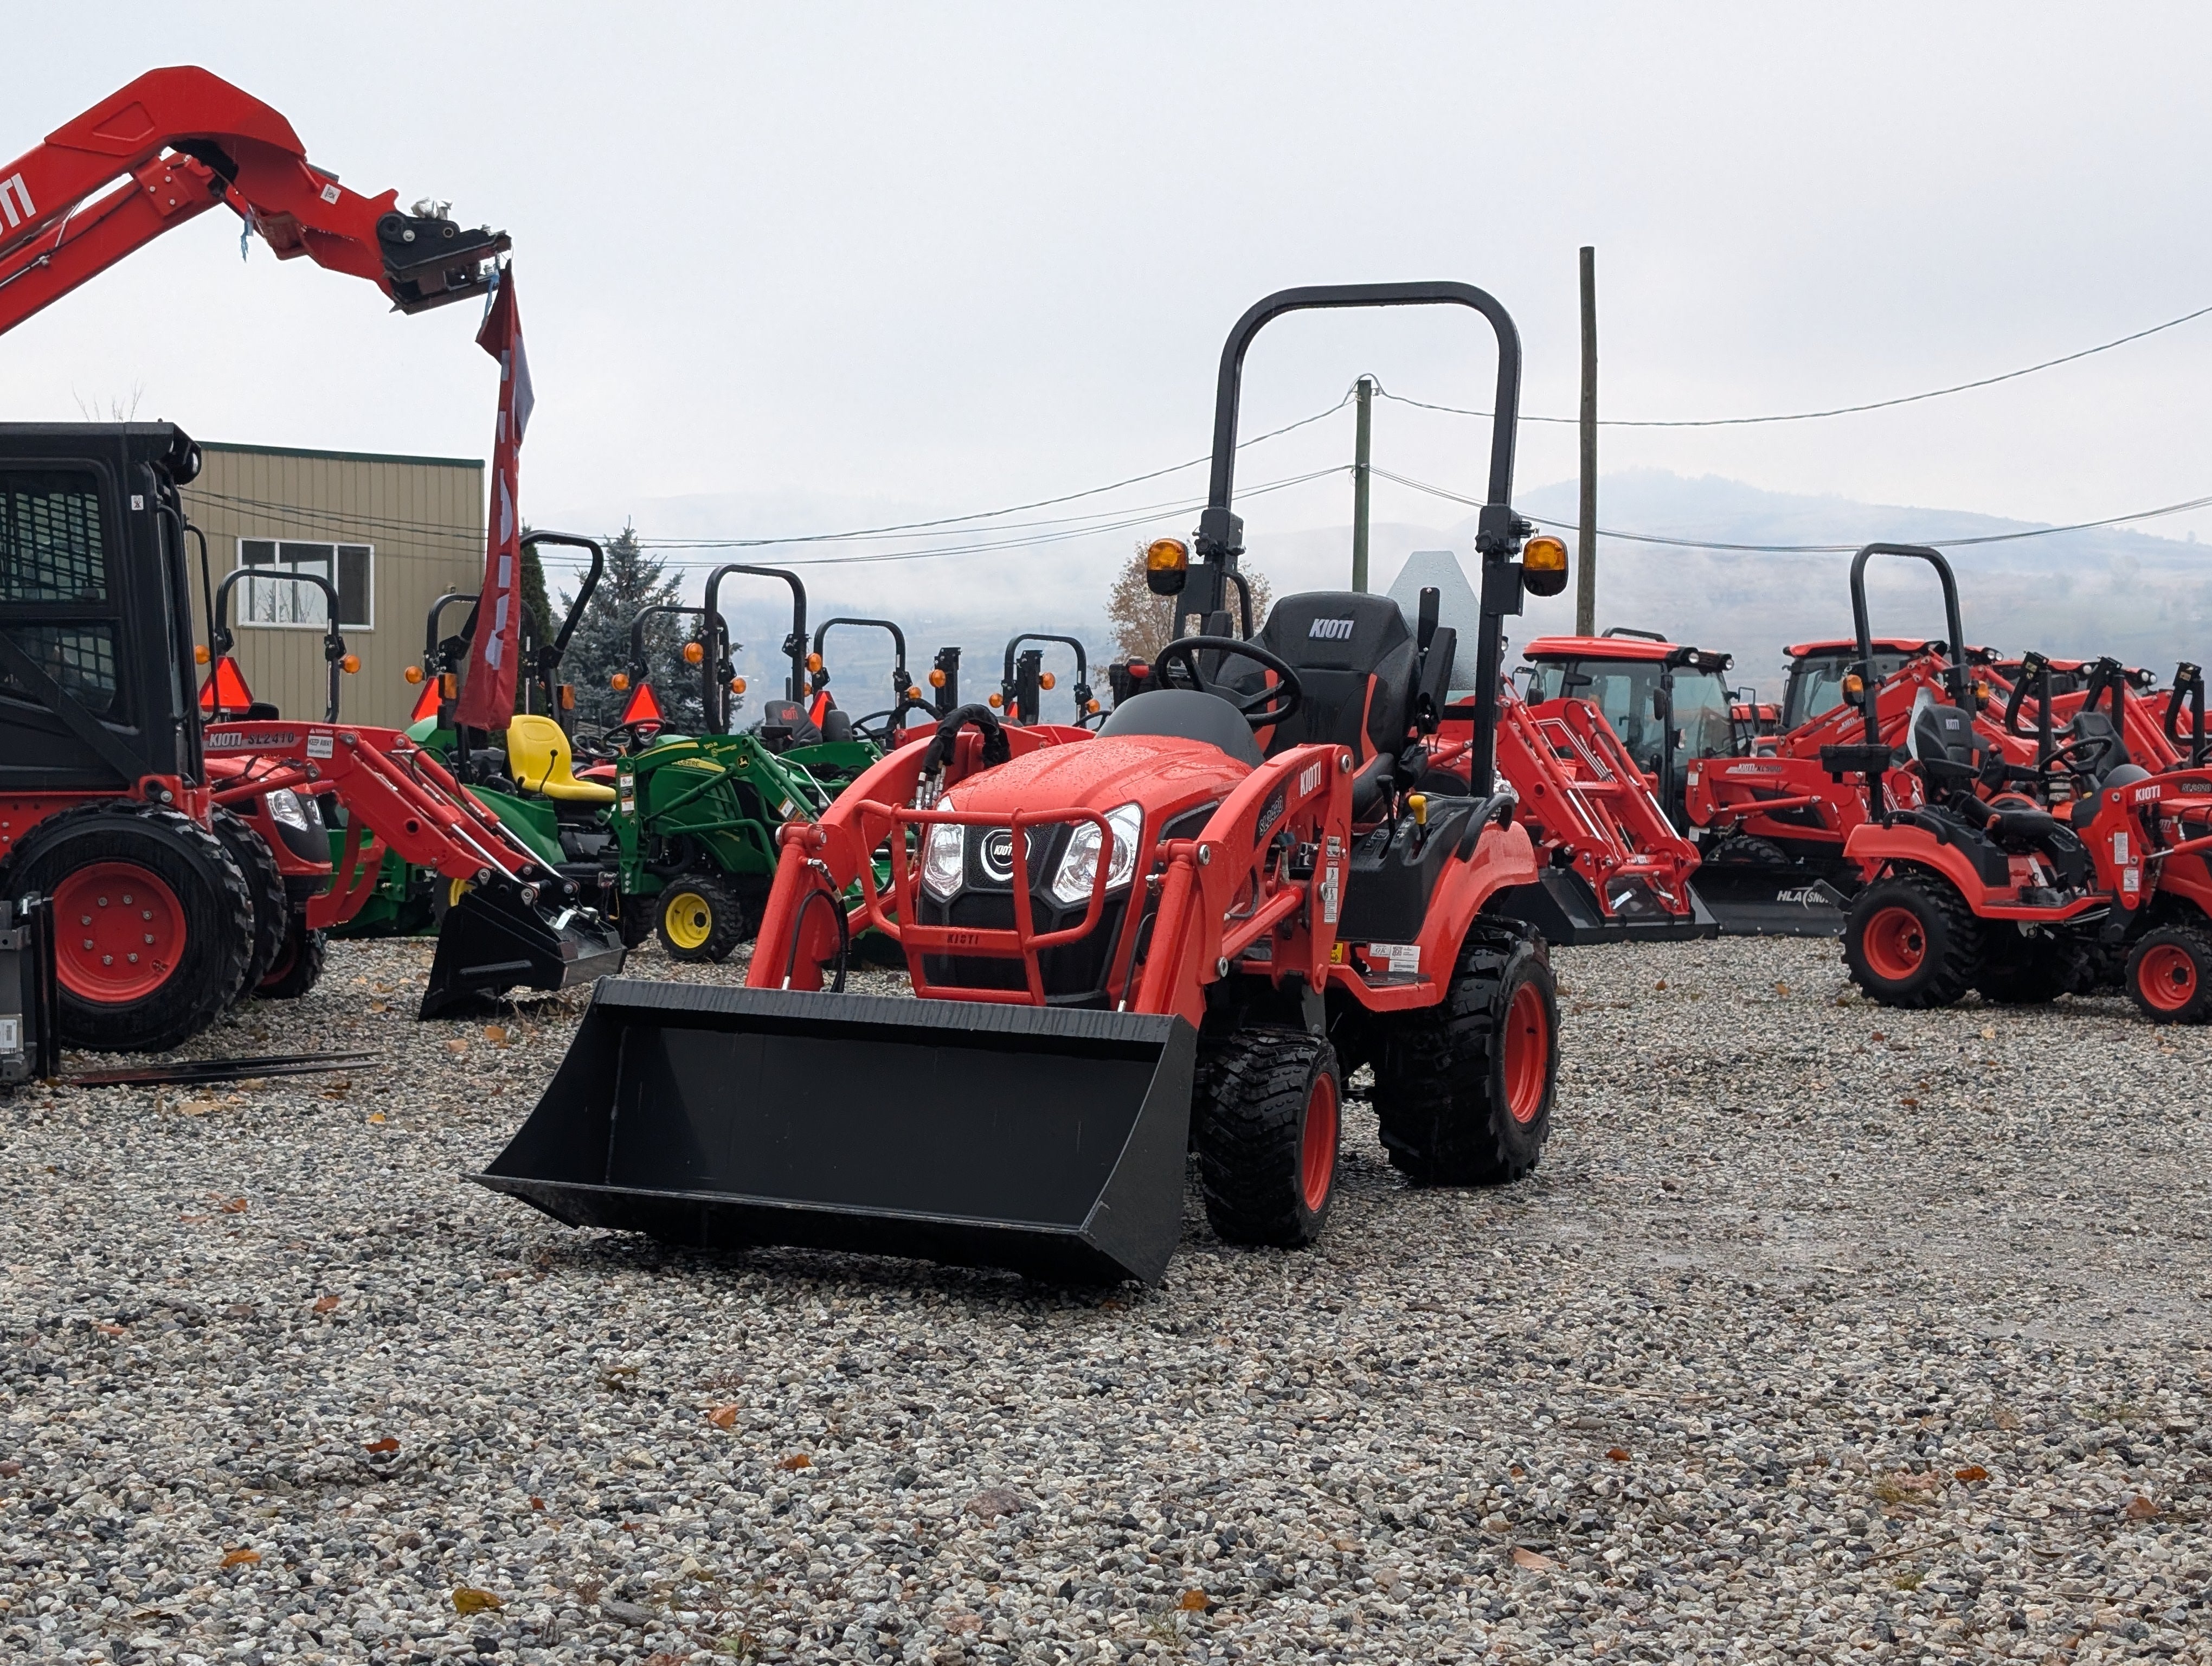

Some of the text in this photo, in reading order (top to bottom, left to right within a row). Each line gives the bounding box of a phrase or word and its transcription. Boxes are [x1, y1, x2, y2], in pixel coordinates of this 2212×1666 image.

[1308, 618, 1355, 639] KIOTI
[209, 732, 295, 747] KIOTI SL2410
[1300, 760, 1321, 798] KIOTI
[2135, 784, 2160, 802] KIOTI
[993, 842, 1013, 856] KIOT
[1777, 889, 1802, 902] HLA
[947, 933, 979, 945] KIOTI
